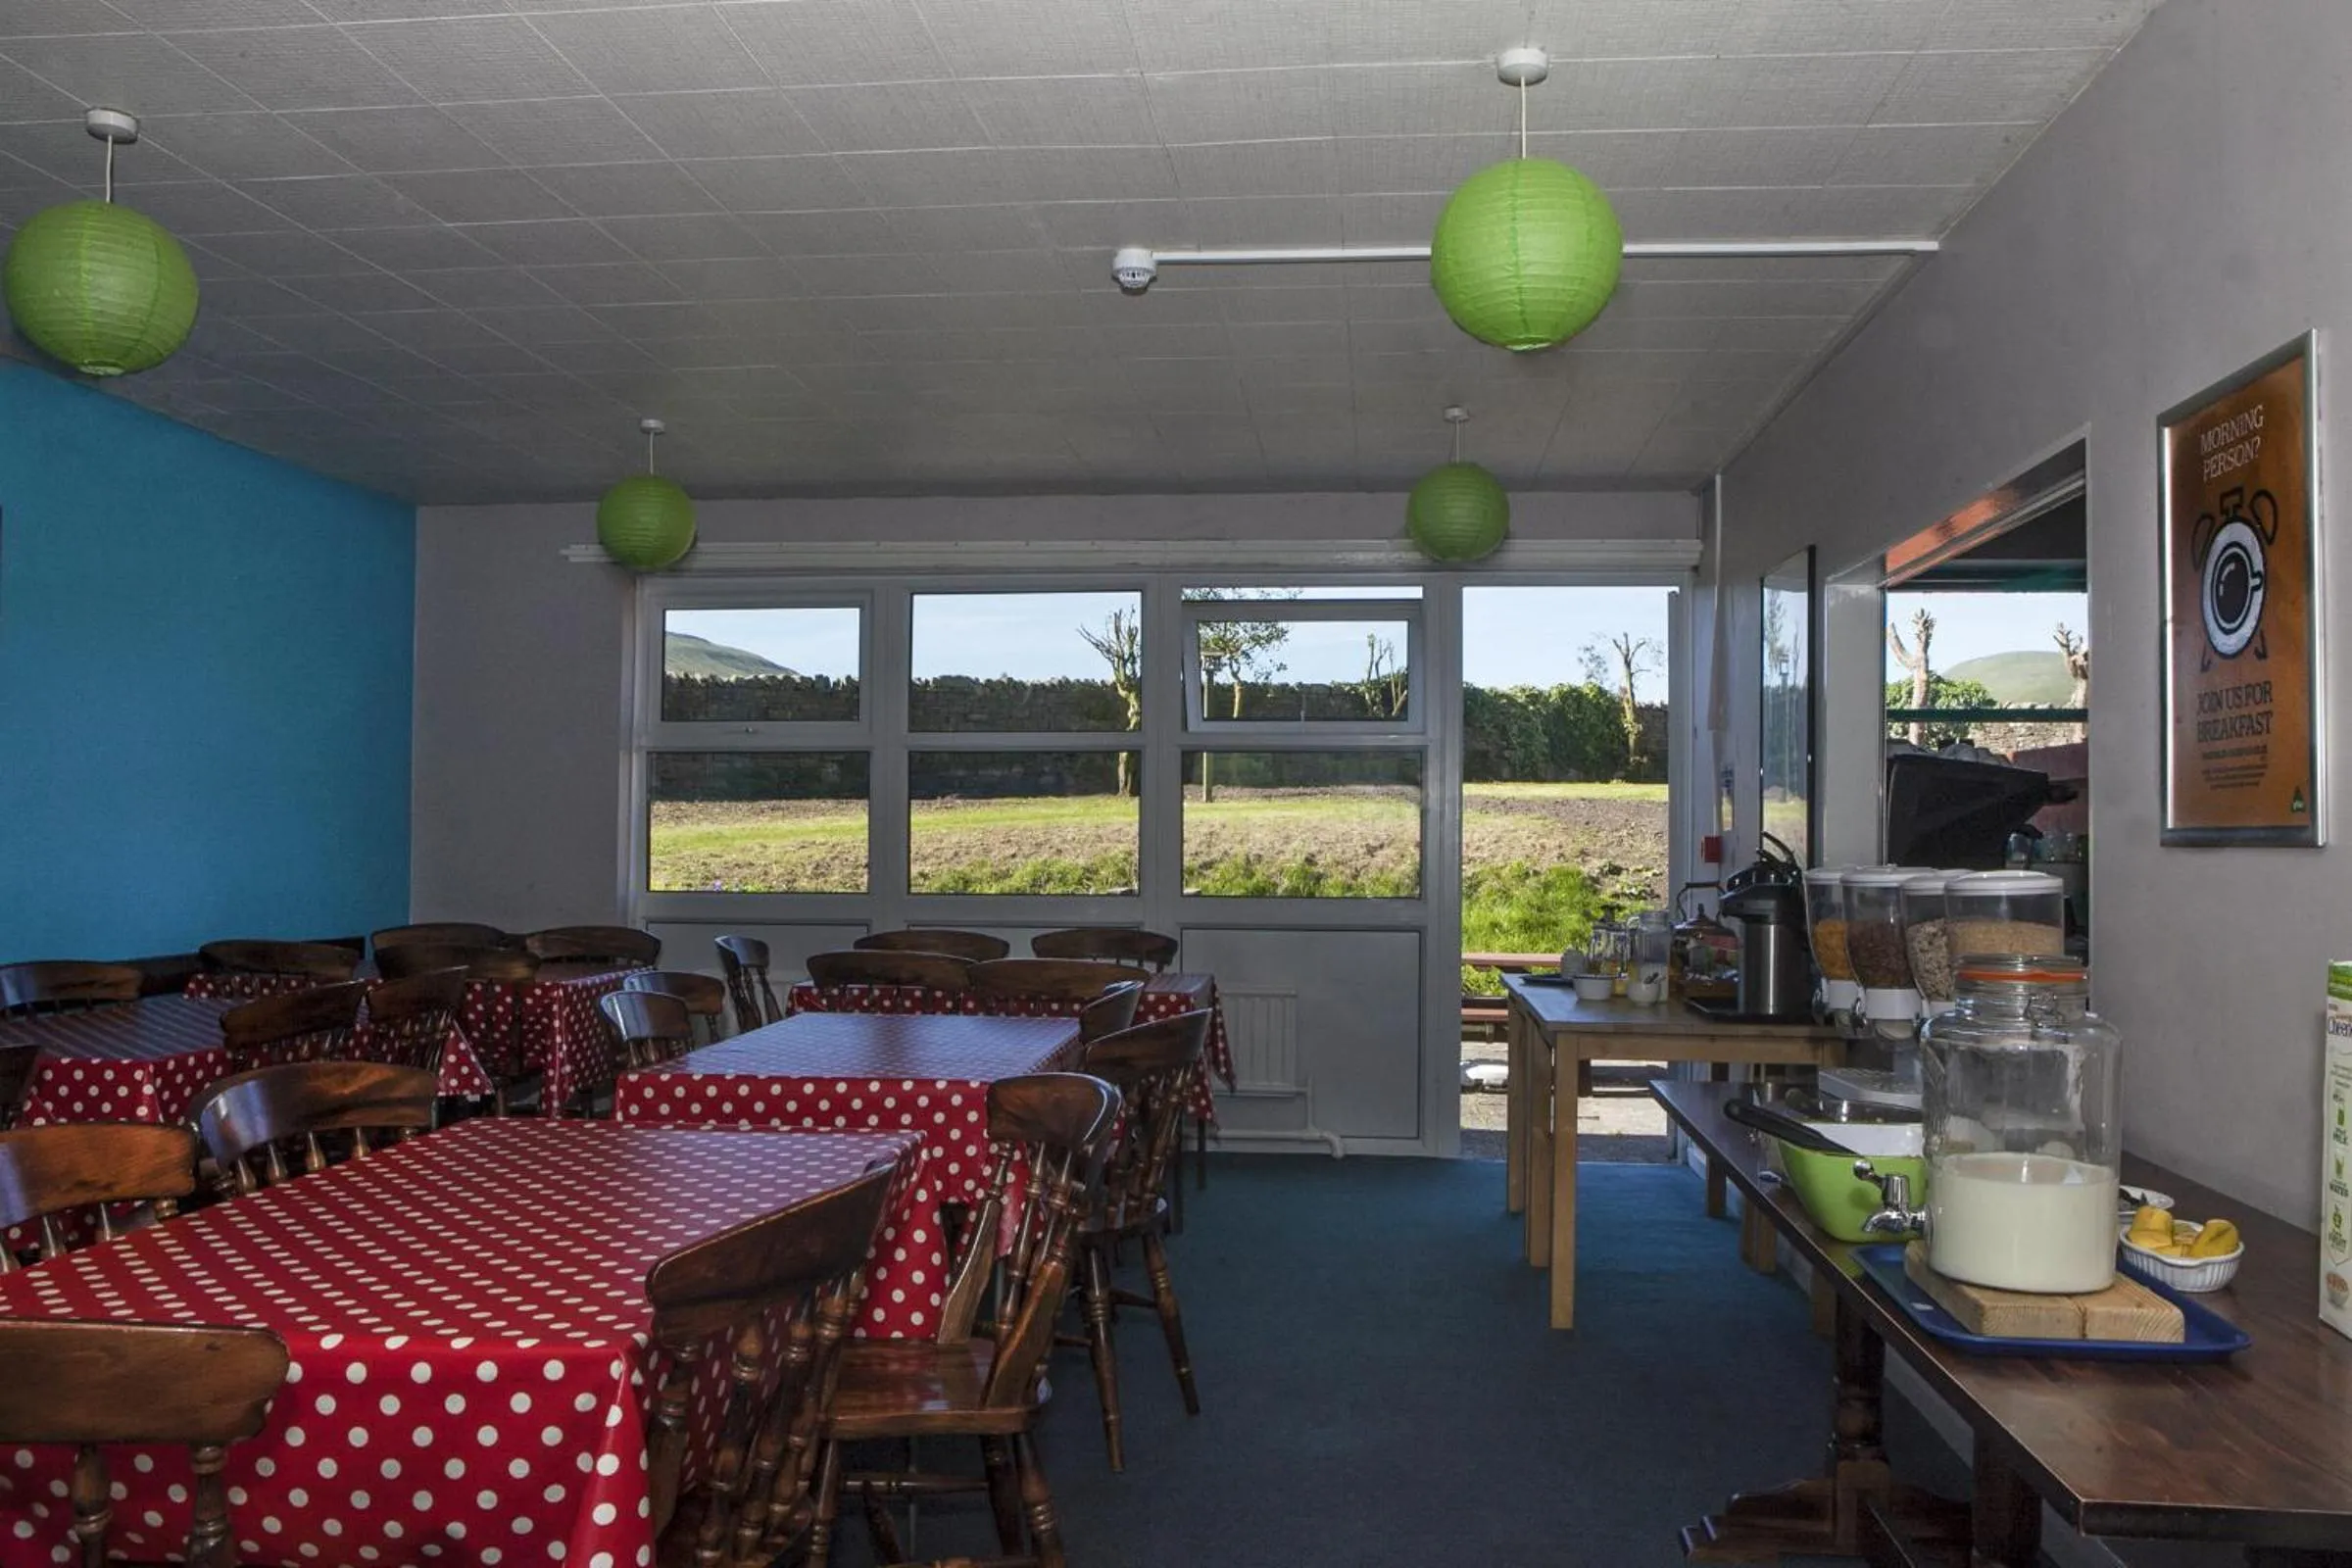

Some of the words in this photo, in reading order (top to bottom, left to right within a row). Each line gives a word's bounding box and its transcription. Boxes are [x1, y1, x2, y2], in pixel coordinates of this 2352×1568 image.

[2200, 404, 2264, 456] MORNING
[2202, 435, 2261, 484] PERSON?
[2197, 690, 2224, 715] JOIN
[2225, 686, 2242, 710] US
[2244, 680, 2273, 707] FOR
[2197, 710, 2274, 743] BREAKFAST
